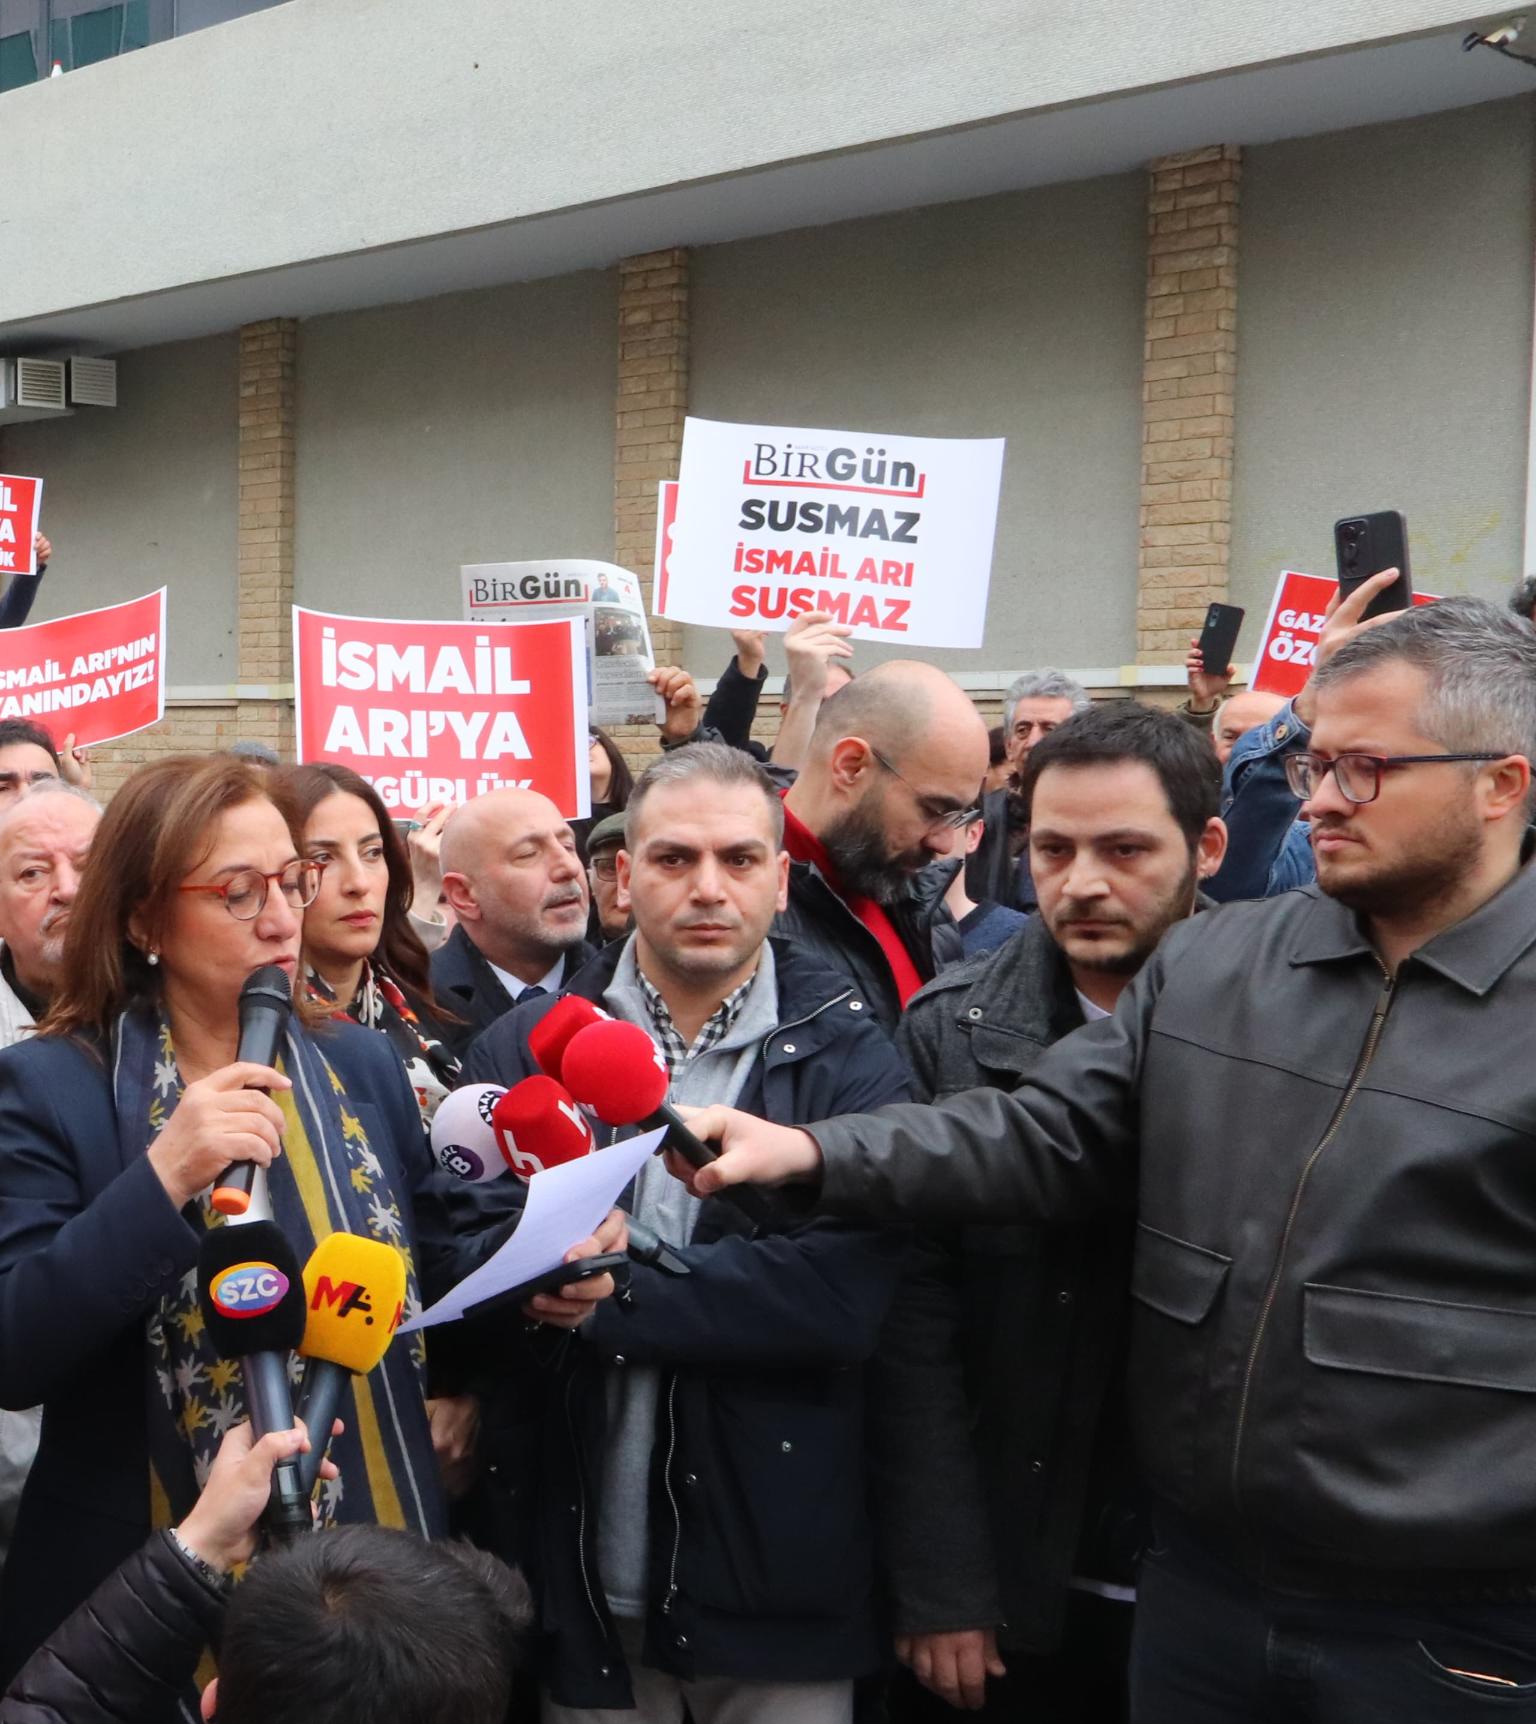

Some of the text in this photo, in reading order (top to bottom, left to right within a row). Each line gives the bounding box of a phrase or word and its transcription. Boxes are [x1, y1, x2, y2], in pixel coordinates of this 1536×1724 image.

[738, 498, 921, 544] SUSMAZ
[733, 541, 914, 588] İSMAİL ARI
[729, 584, 912, 632] SUSMAZ
[70, 633, 156, 678] ARI'NIN
[322, 626, 531, 695] İSMAİL
[323, 705, 533, 760] ARI'YA
[221, 1273, 279, 1305] SZC
